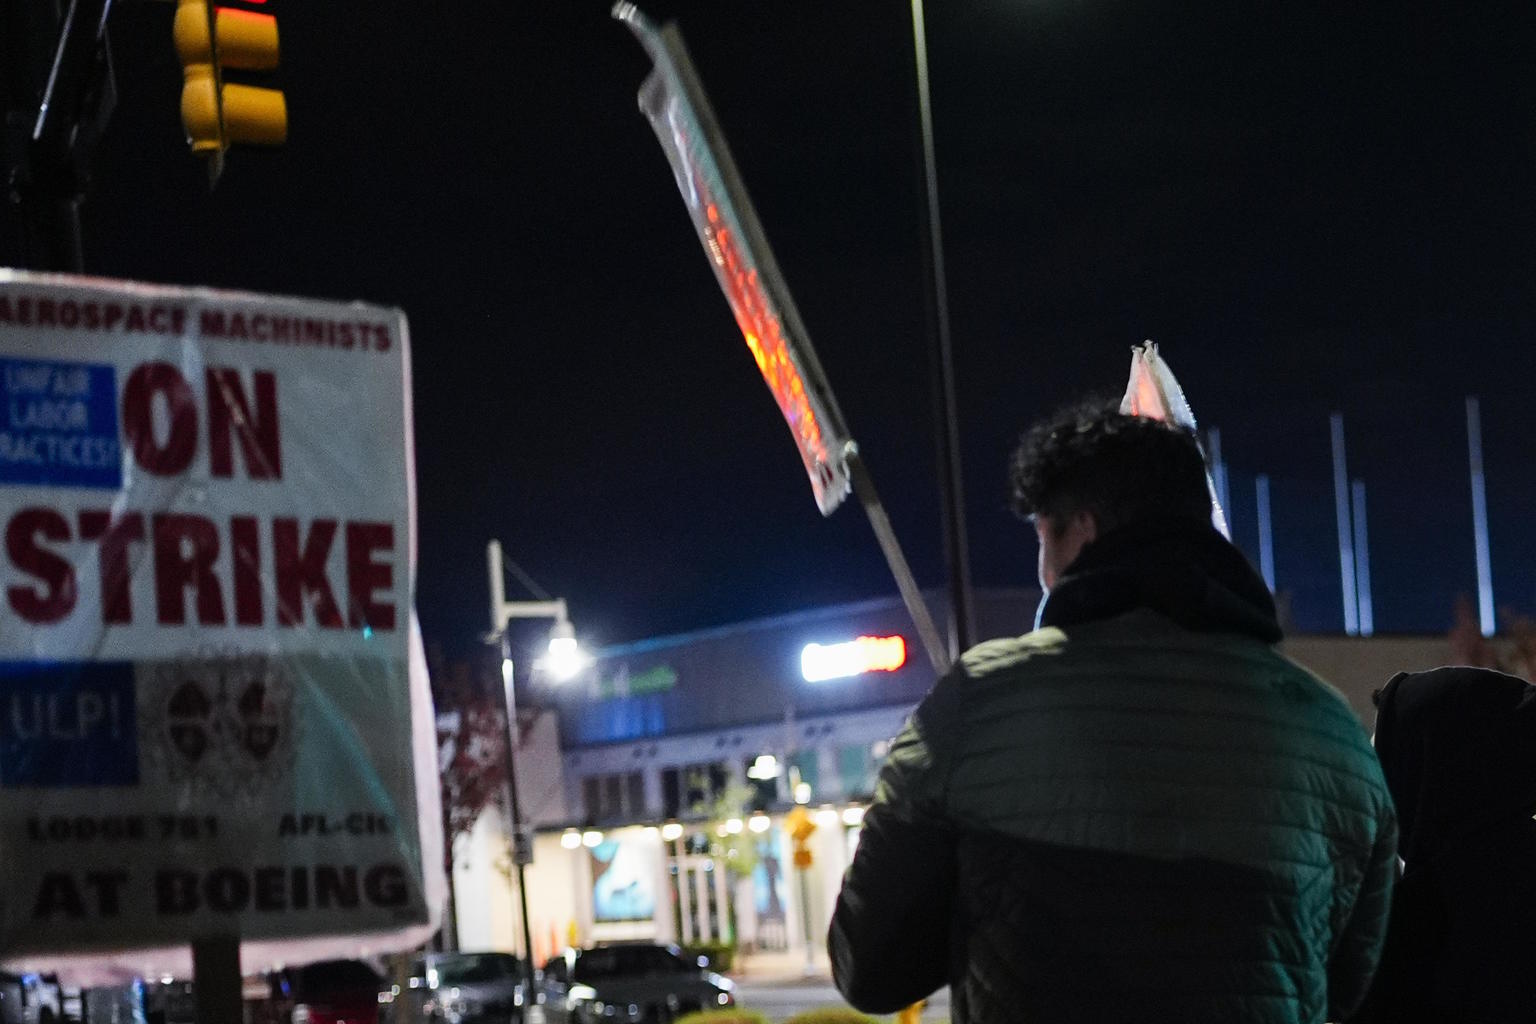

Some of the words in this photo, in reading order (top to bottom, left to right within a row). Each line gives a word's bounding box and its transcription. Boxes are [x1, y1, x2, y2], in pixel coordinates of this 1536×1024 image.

[200, 308, 392, 352] MACHINISTS
[121, 360, 283, 481] ON
[4, 506, 396, 631] STRIKE
[32, 868, 128, 920] AT
[156, 864, 409, 915] BOEING
